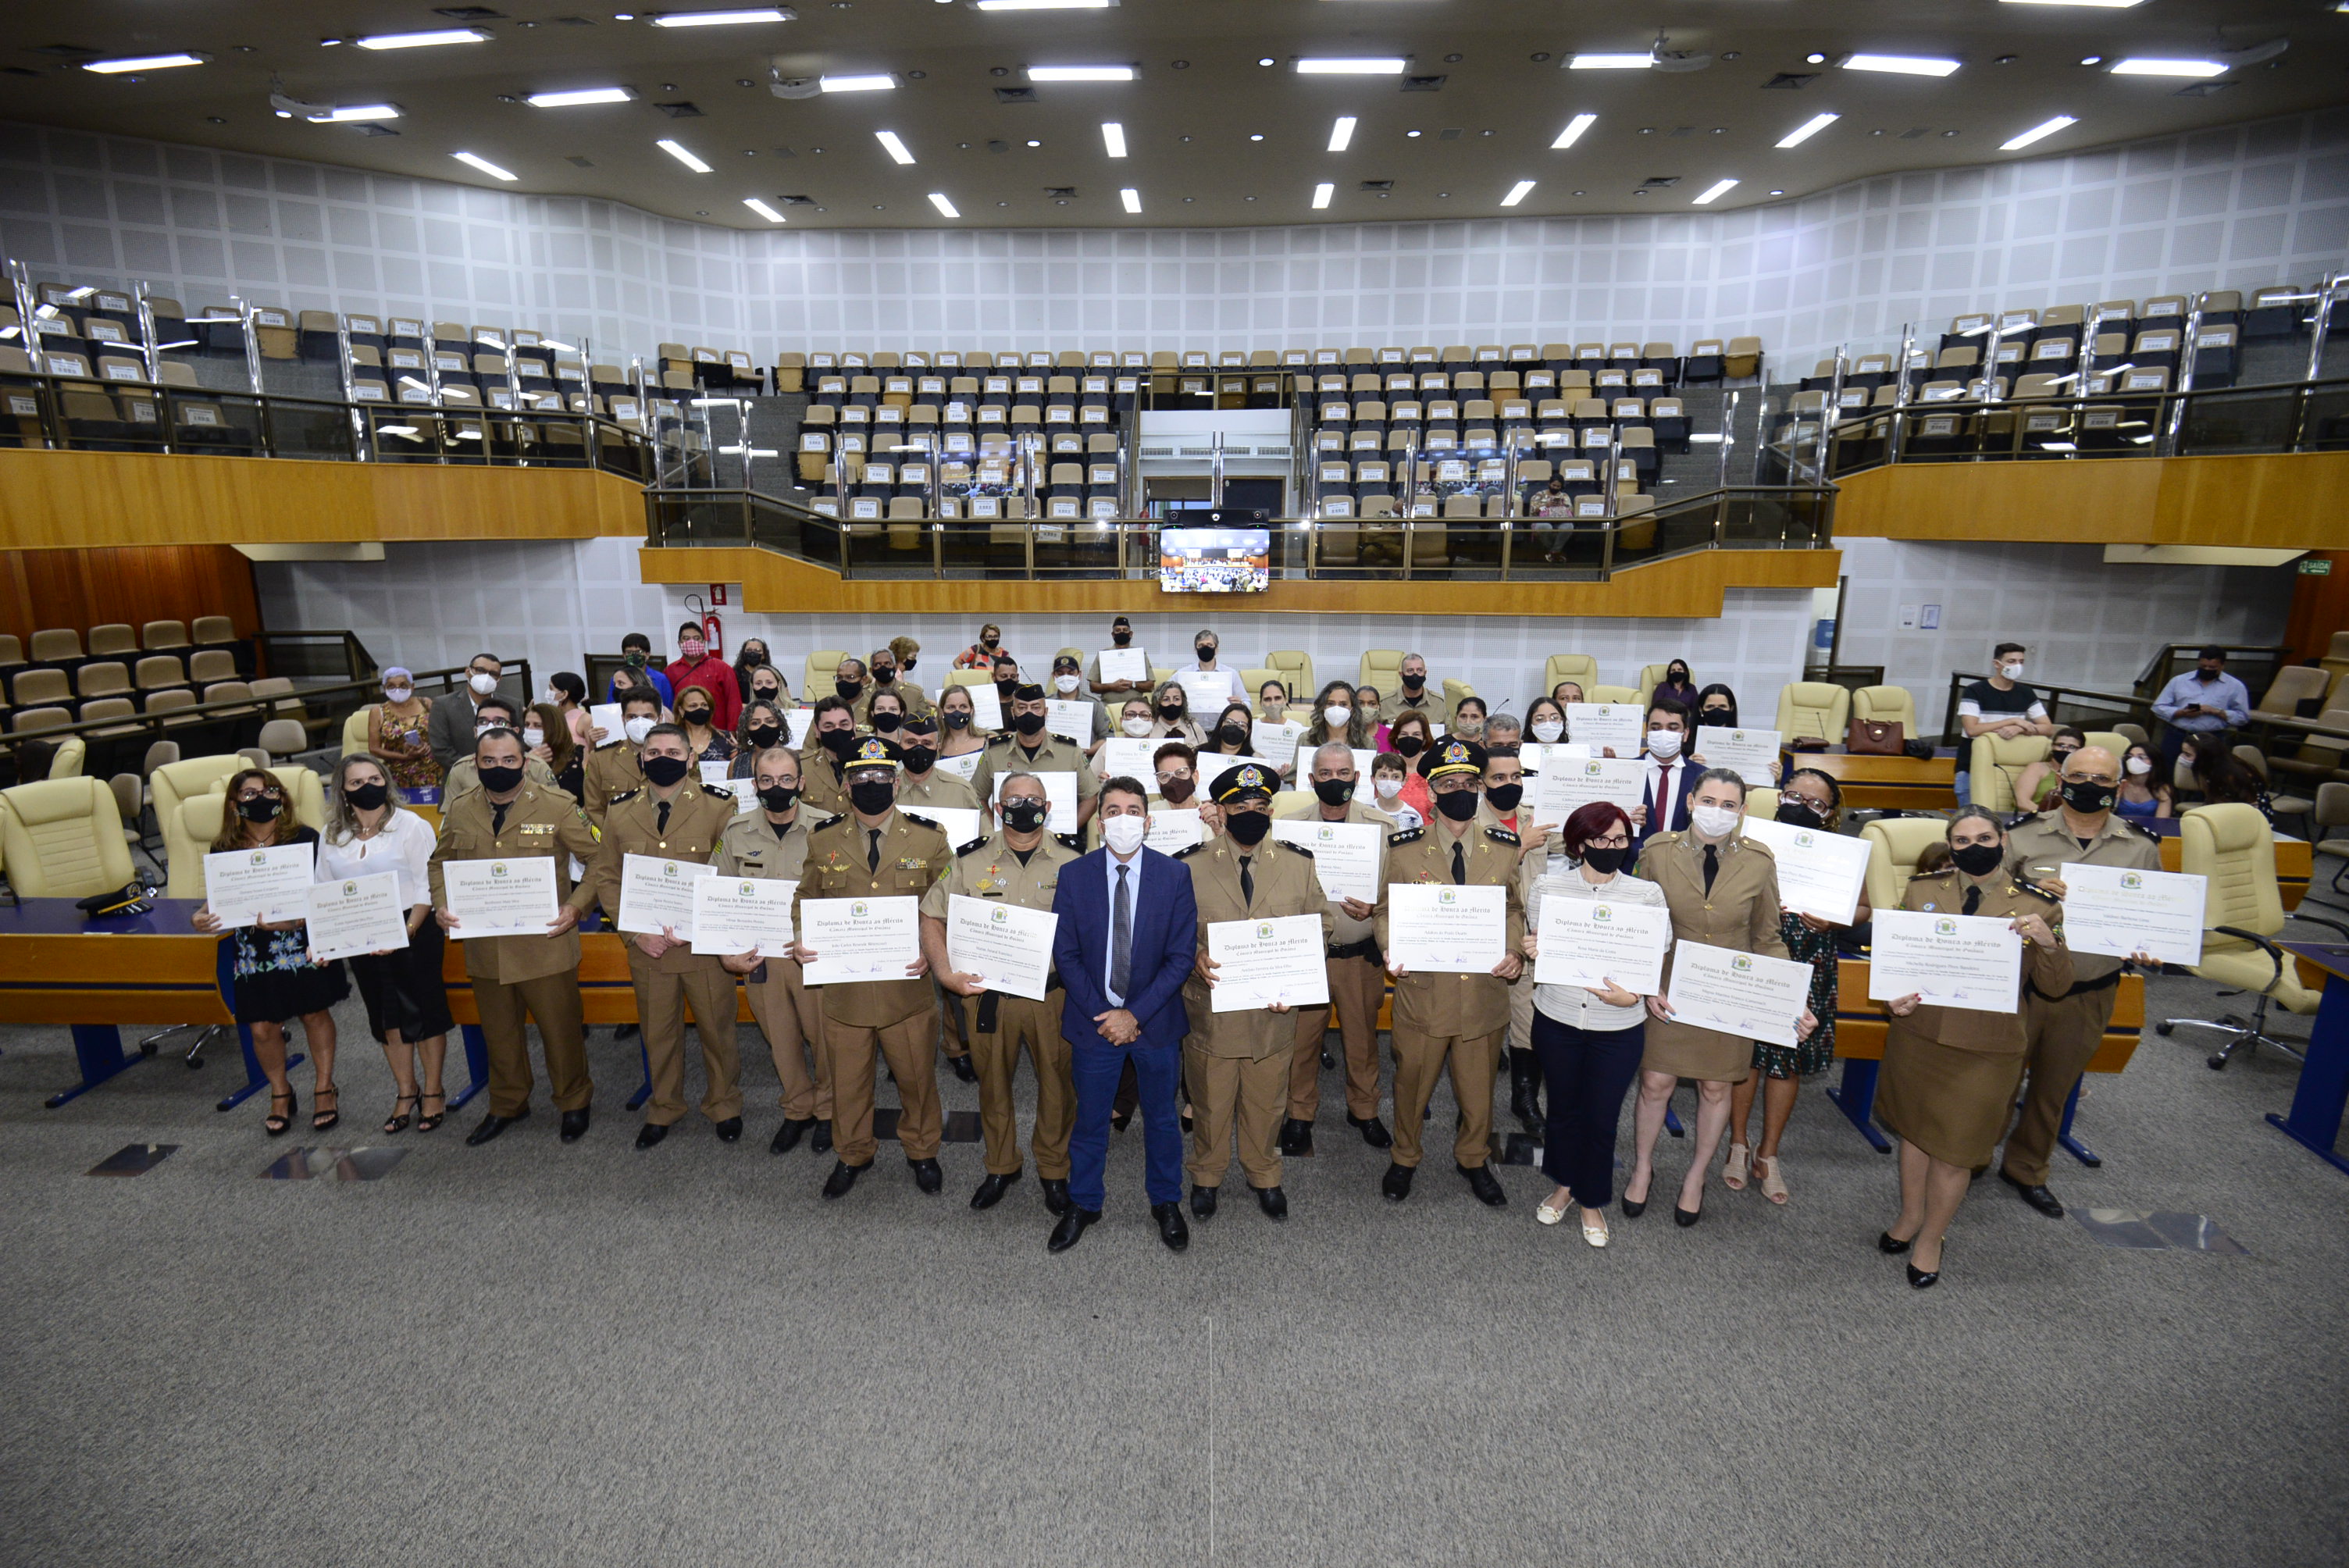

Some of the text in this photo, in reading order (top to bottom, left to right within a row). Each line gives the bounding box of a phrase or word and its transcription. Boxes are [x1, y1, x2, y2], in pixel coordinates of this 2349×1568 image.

[960, 918, 982, 928] Diploma
[992, 924, 1010, 933] Honra
[1555, 918, 1583, 928] Diploma
[1224, 943, 1249, 951] Diploma
[1891, 933, 1923, 943] Diploma
[1974, 939, 2001, 948] Mérito
[1690, 963, 1720, 975] Diploma
[1731, 971, 1755, 981] Honra
[1766, 978, 1791, 988] Mérito
[1723, 977, 1747, 986] Municipal
[1754, 983, 1774, 992] Goiânia
